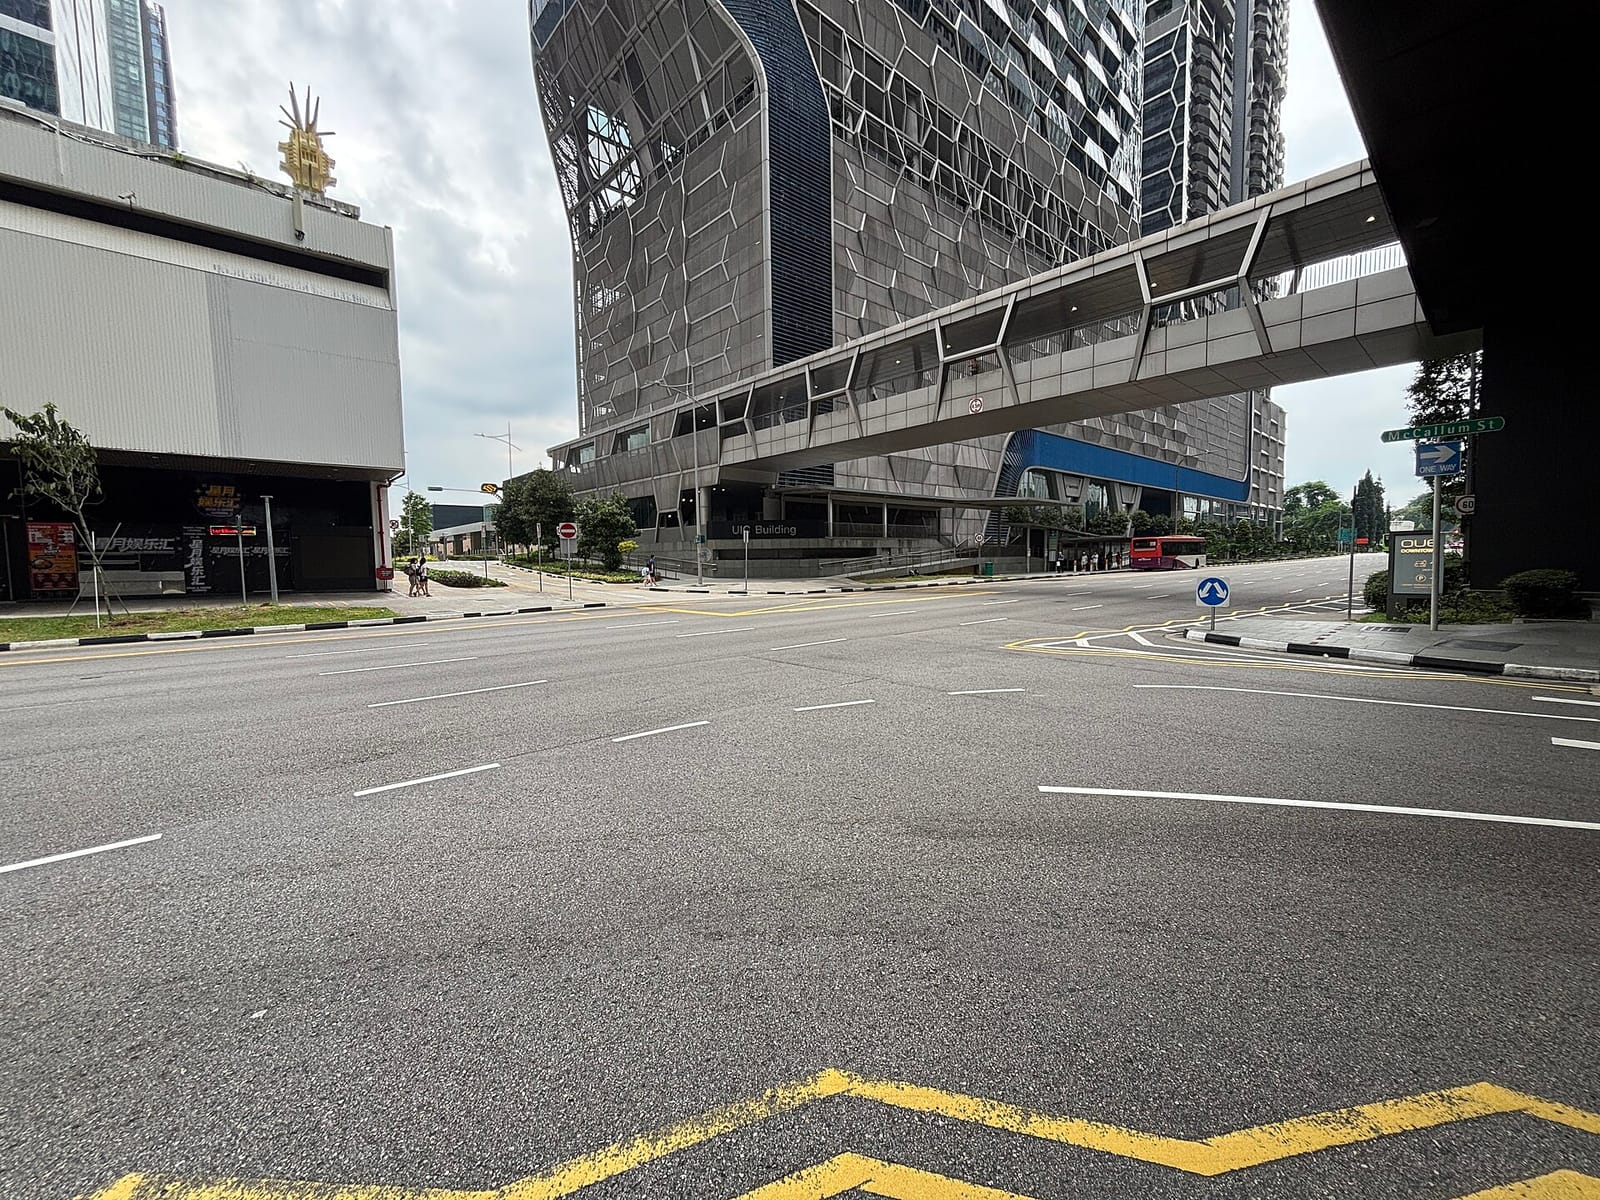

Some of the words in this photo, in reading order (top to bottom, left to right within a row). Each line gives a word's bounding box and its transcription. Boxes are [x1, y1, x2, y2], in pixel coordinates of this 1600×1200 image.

[1388, 425, 1470, 440] McCallum
[1477, 420, 1495, 430] St
[1419, 465, 1436, 473] ONE
[1440, 464, 1457, 472] WAY
[755, 525, 797, 536] Building
